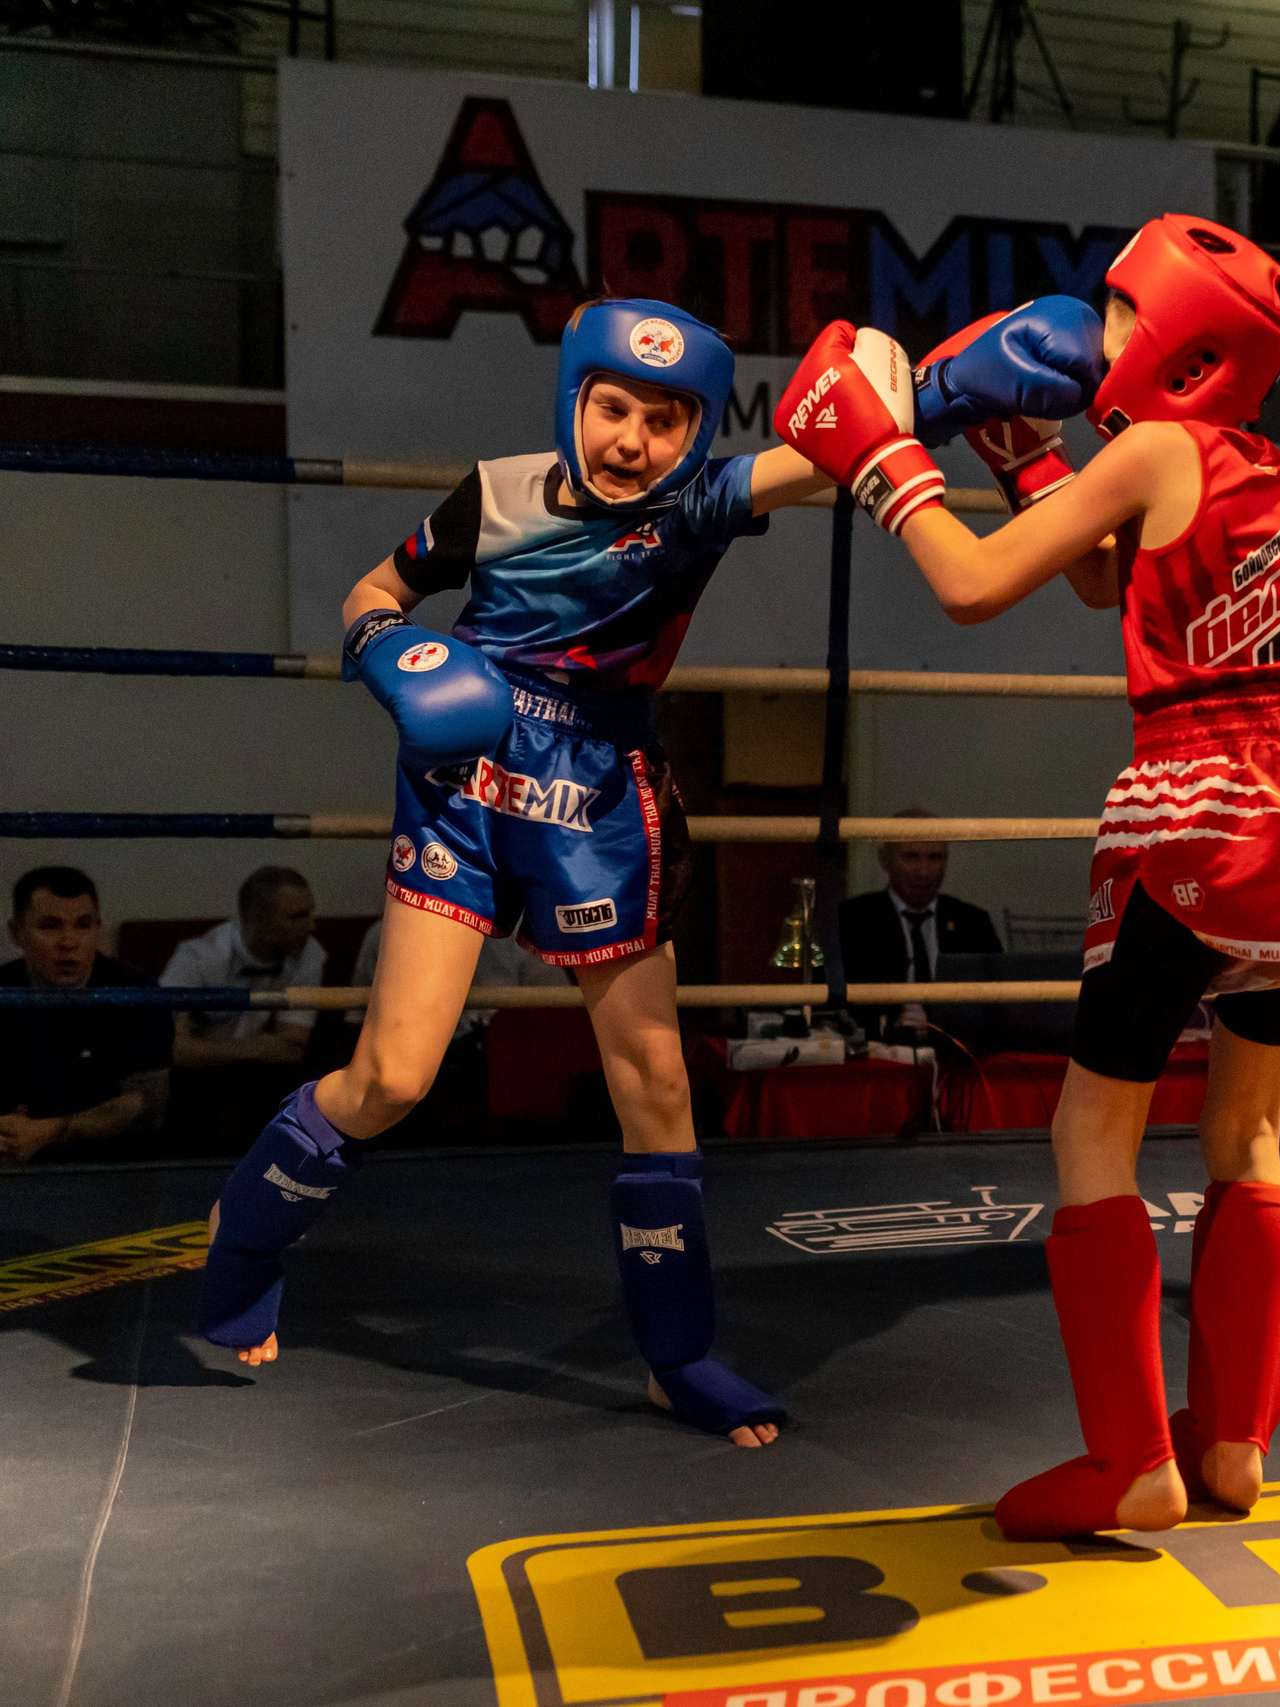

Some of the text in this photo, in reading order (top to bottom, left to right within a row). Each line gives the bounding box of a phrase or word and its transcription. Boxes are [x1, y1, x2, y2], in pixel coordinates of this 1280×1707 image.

[400, 888, 423, 907] THAI
[423, 897, 456, 918] MUAY
[584, 948, 615, 965] MUAY
[617, 939, 647, 958] THAI
